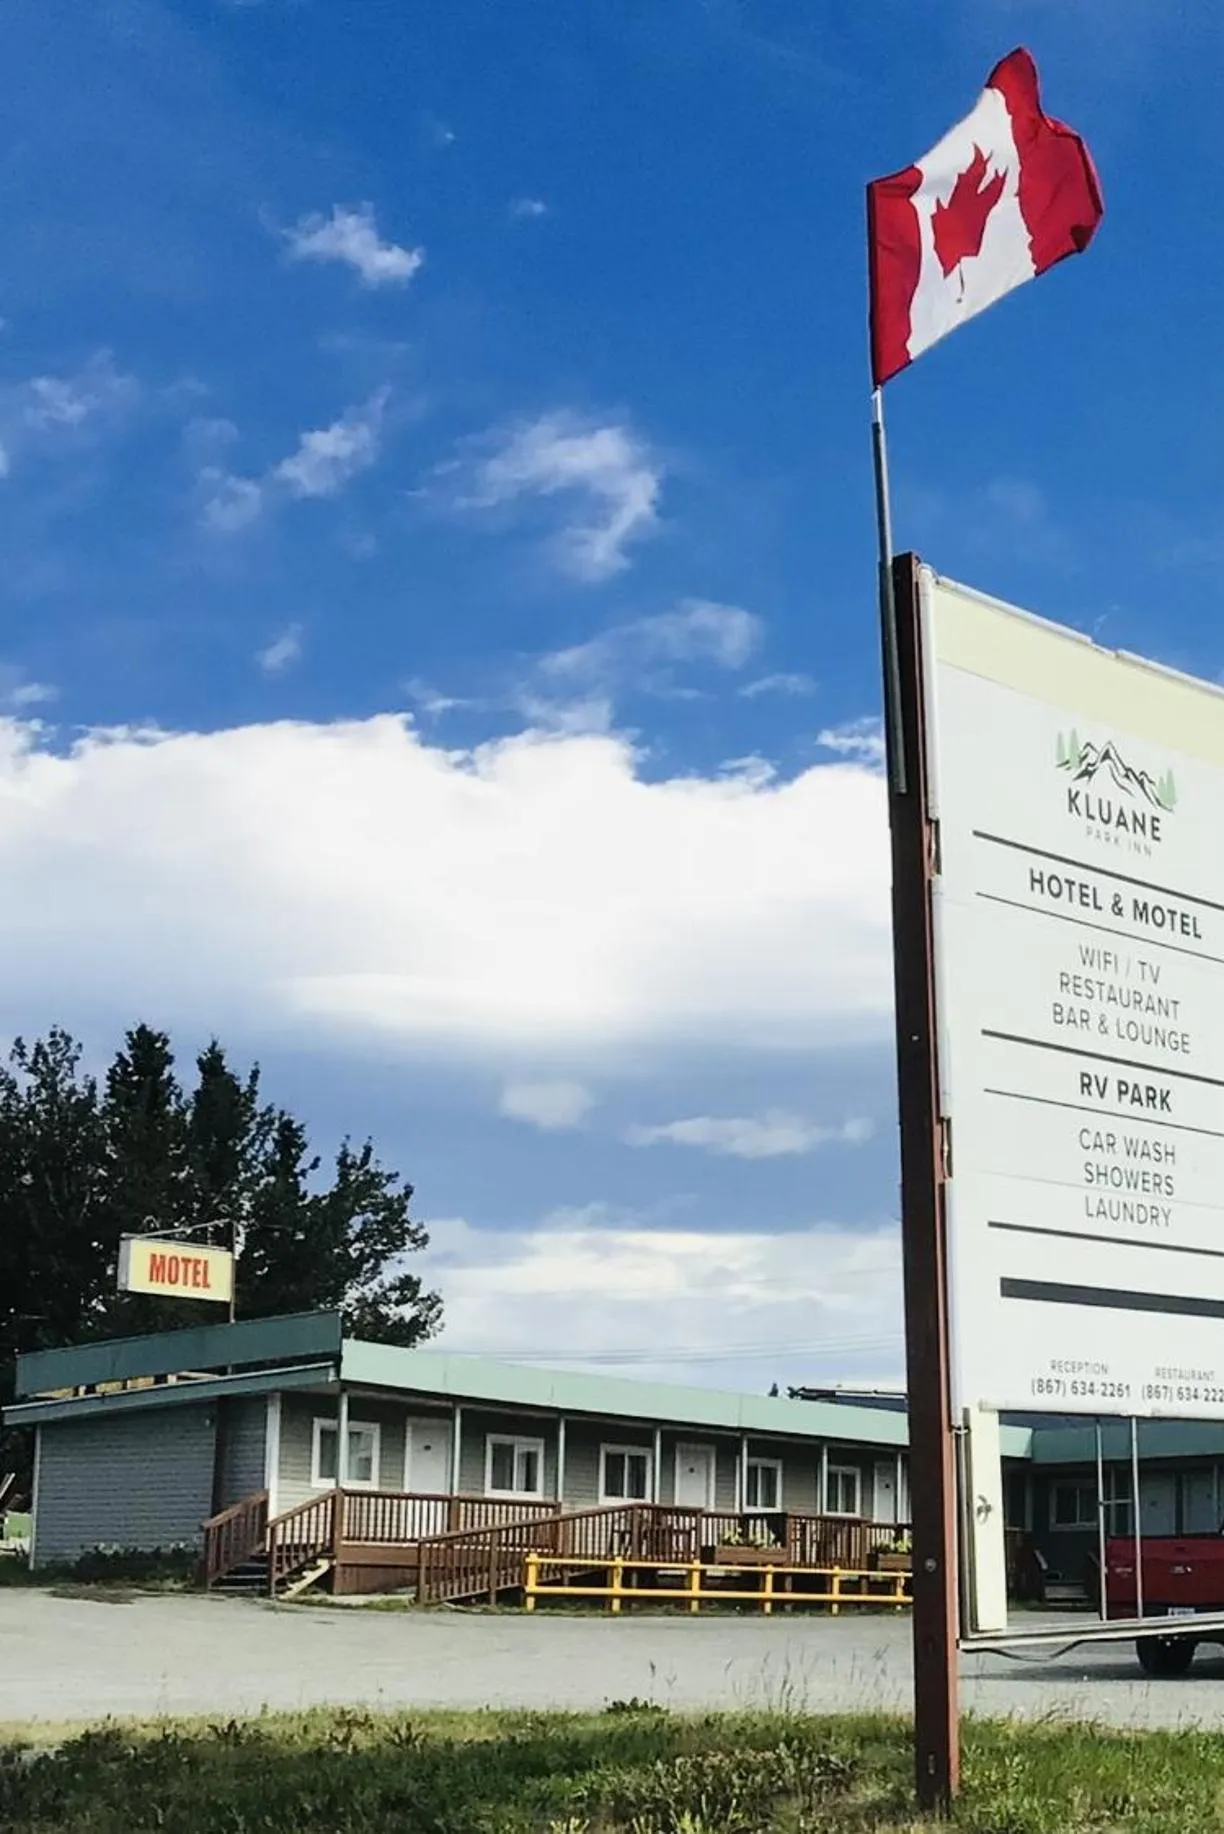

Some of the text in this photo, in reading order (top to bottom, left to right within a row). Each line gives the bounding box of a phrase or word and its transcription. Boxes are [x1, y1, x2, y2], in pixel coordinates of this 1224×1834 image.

[1068, 788, 1162, 842] KLUANE
[1086, 825, 1152, 857] PARK INN
[1029, 868, 1202, 939] HOTEL & MOTEL
[1079, 945, 1119, 973] WIFI
[1138, 960, 1161, 984] TV
[1060, 972, 1180, 1020] RESTAURANT
[1053, 1002, 1191, 1054] BAR & LOUNGE
[1080, 1071, 1172, 1112] RV PARK
[1079, 1128, 1176, 1165] CAR WASH
[1084, 1161, 1175, 1197] SHOWERS
[1084, 1195, 1173, 1228] LAUNDRY
[148, 1253, 211, 1289] MOTEL
[1050, 1359, 1215, 1382] RECEPTION RESTAURANT
[1031, 1378, 1067, 1397] (867)
[1141, 1384, 1173, 1401] (867)
